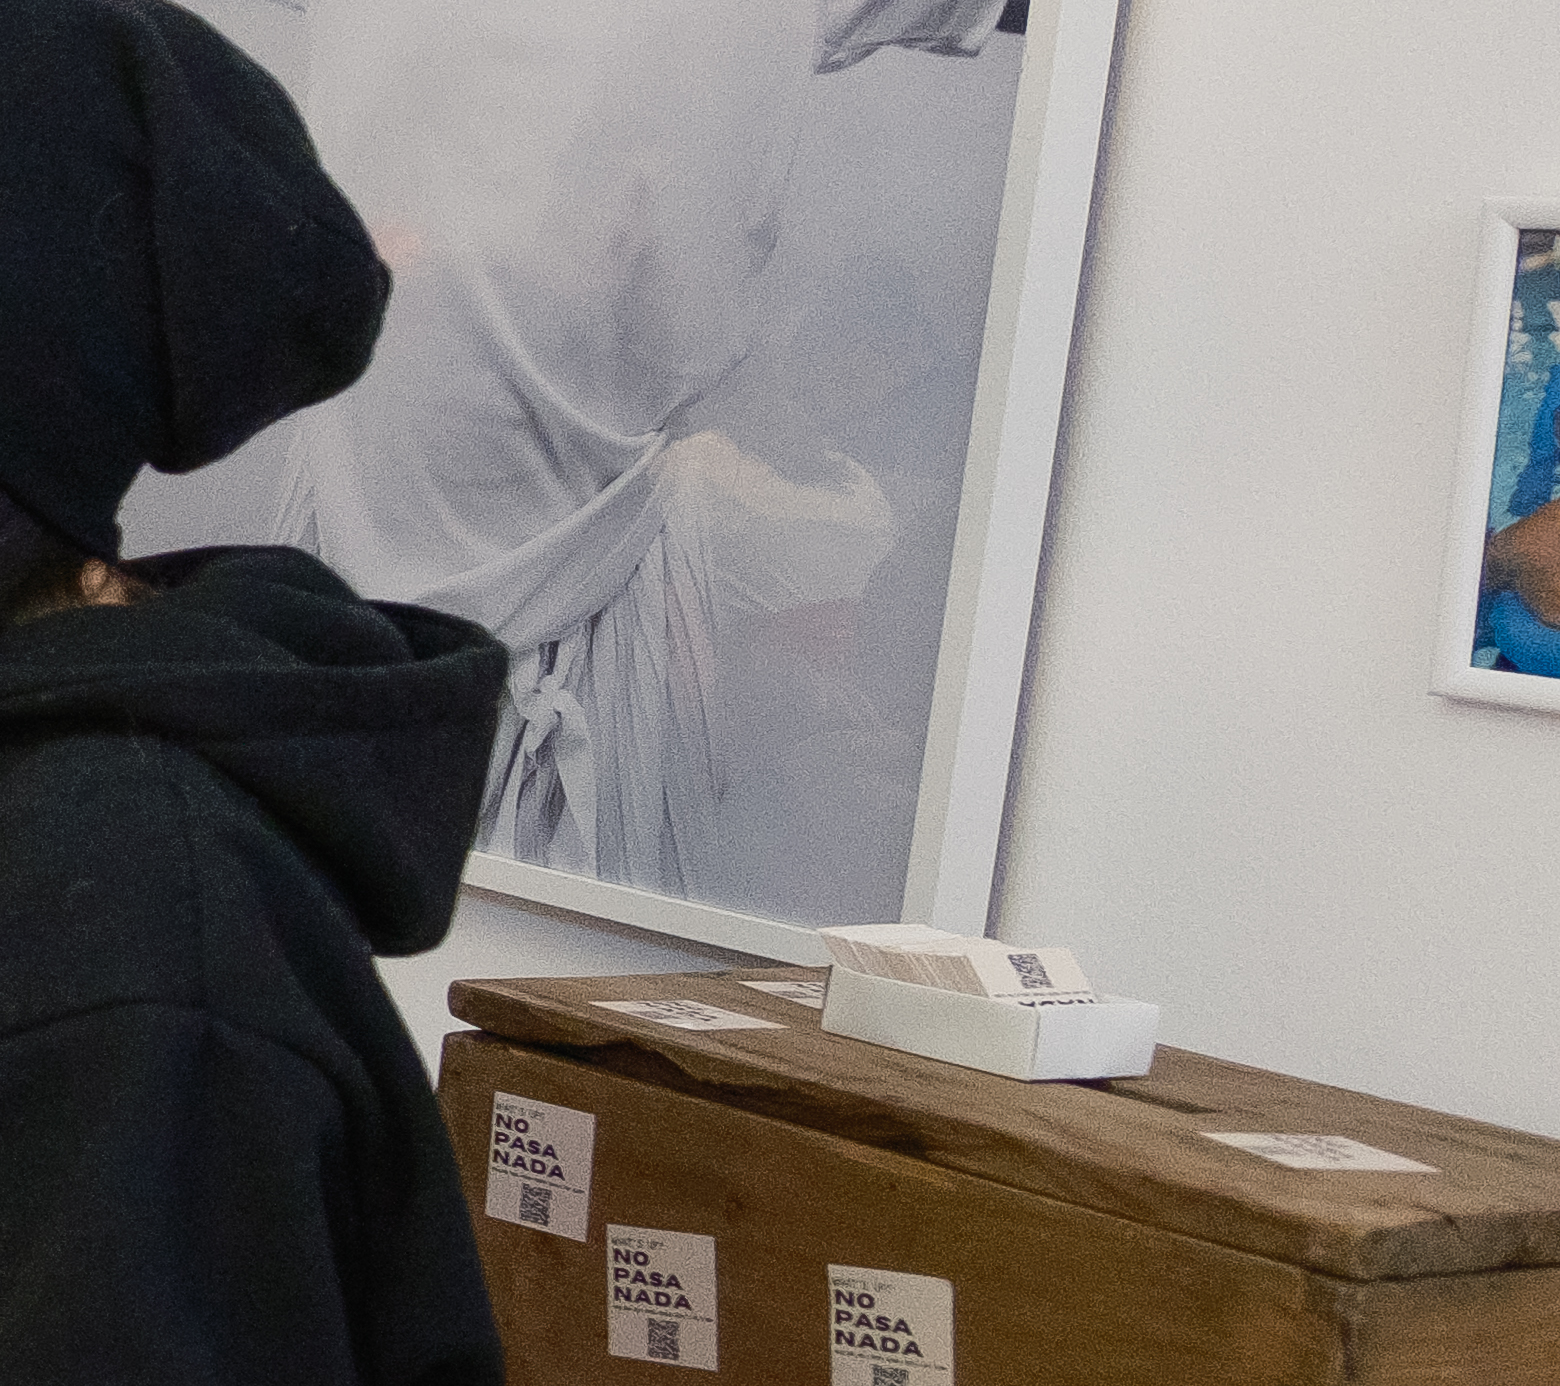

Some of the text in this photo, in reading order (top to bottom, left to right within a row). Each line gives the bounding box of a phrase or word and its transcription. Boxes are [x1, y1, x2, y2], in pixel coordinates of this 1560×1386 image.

[495, 1113, 530, 1134] NO
[493, 1131, 559, 1161] PASA
[491, 1148, 566, 1181] NADA
[613, 1247, 650, 1267] NO
[613, 1267, 684, 1291] PASA
[613, 1285, 693, 1311] NADA
[834, 1289, 876, 1310] NO
[834, 1309, 914, 1336] PASA
[834, 1329, 925, 1359] NADA
